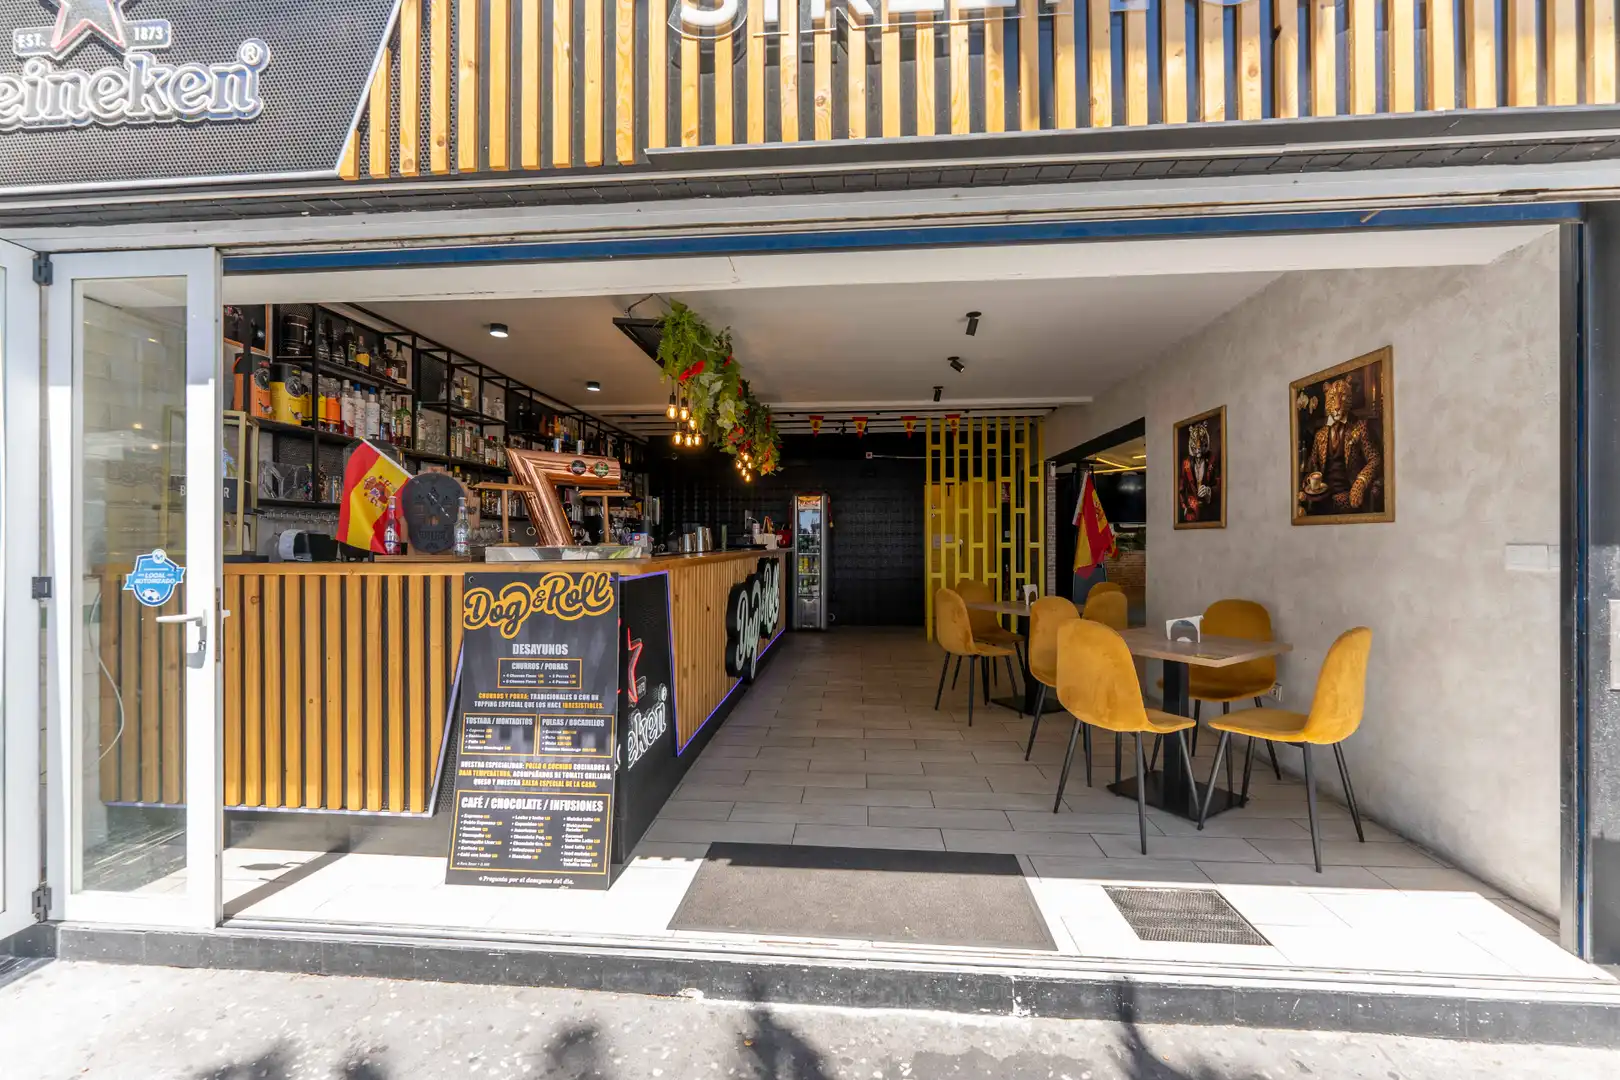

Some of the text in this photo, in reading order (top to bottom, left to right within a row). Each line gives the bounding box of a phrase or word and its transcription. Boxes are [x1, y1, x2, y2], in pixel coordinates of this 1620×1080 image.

[134, 26, 164, 41] 1873
[18, 33, 46, 48] EST.
[0, 53, 261, 125] eineken
[464, 583, 531, 638] Dog
[543, 572, 613, 618] Roll
[512, 643, 569, 656] DESAYUNOS
[511, 662, 540, 671] CHURROS
[544, 662, 569, 671] PORRAS
[474, 700, 498, 708] TOPPING
[498, 700, 523, 708] ESPECIAL
[547, 701, 562, 709] HACE
[496, 717, 533, 726] MONTADITOS
[542, 718, 564, 726] PULGAS
[569, 719, 605, 727] BOCADILLOS
[460, 760, 485, 768] NUESTRA
[485, 760, 525, 769] ESPECIALIDAD:
[573, 763, 605, 771] COCINADOS
[473, 778, 491, 786] QUESO
[521, 779, 539, 787] SALSA
[461, 795, 484, 809] CAFÉ
[490, 797, 542, 810] CHOCOLATE
[549, 799, 603, 812] INFUSIONES
